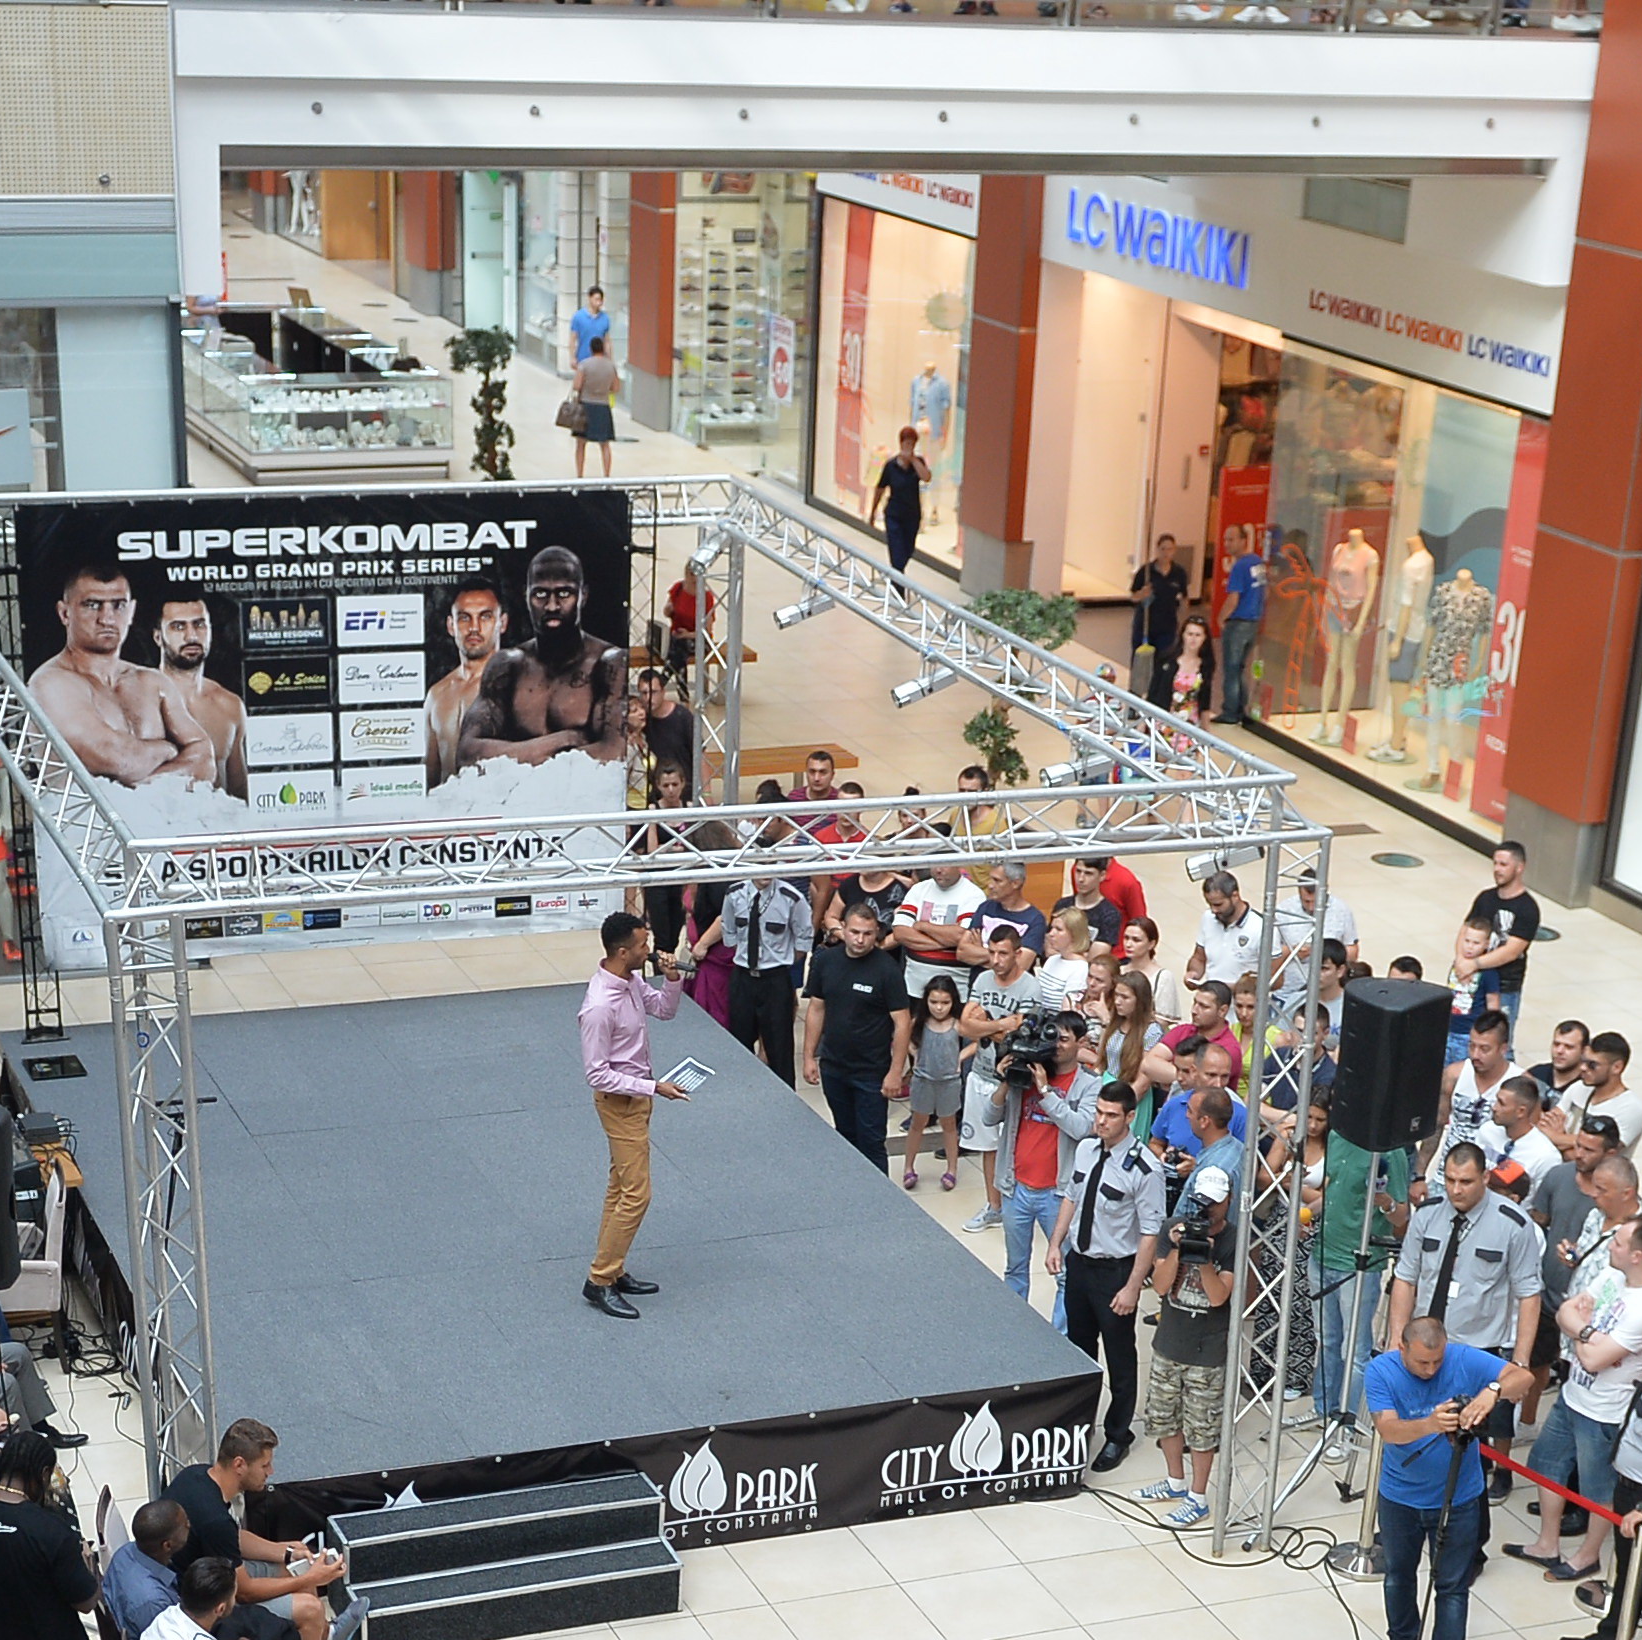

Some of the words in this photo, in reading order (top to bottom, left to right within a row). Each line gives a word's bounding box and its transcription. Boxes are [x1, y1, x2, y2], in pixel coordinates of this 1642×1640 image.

[1067, 187, 1109, 250] LC
[1309, 288, 1327, 312] LC
[1385, 310, 1404, 335] LC
[1467, 333, 1486, 360] LC
[117, 520, 537, 561] SUPERKOMBAT
[166, 564, 247, 582] WORLD
[256, 561, 332, 579] GRAND
[342, 559, 395, 576] PRIX
[257, 580, 268, 590] PE
[319, 578, 333, 589] CU
[257, 793, 277, 808] CITY
[299, 790, 326, 806] PARK
[881, 1442, 945, 1491] CITY
[1011, 1423, 1090, 1472] PARK
[735, 1462, 819, 1511] PARK
[880, 1489, 927, 1508] MALL
[941, 1484, 968, 1501] OF
[664, 1525, 689, 1541] OF
[704, 1505, 819, 1534] CONSTANTA
